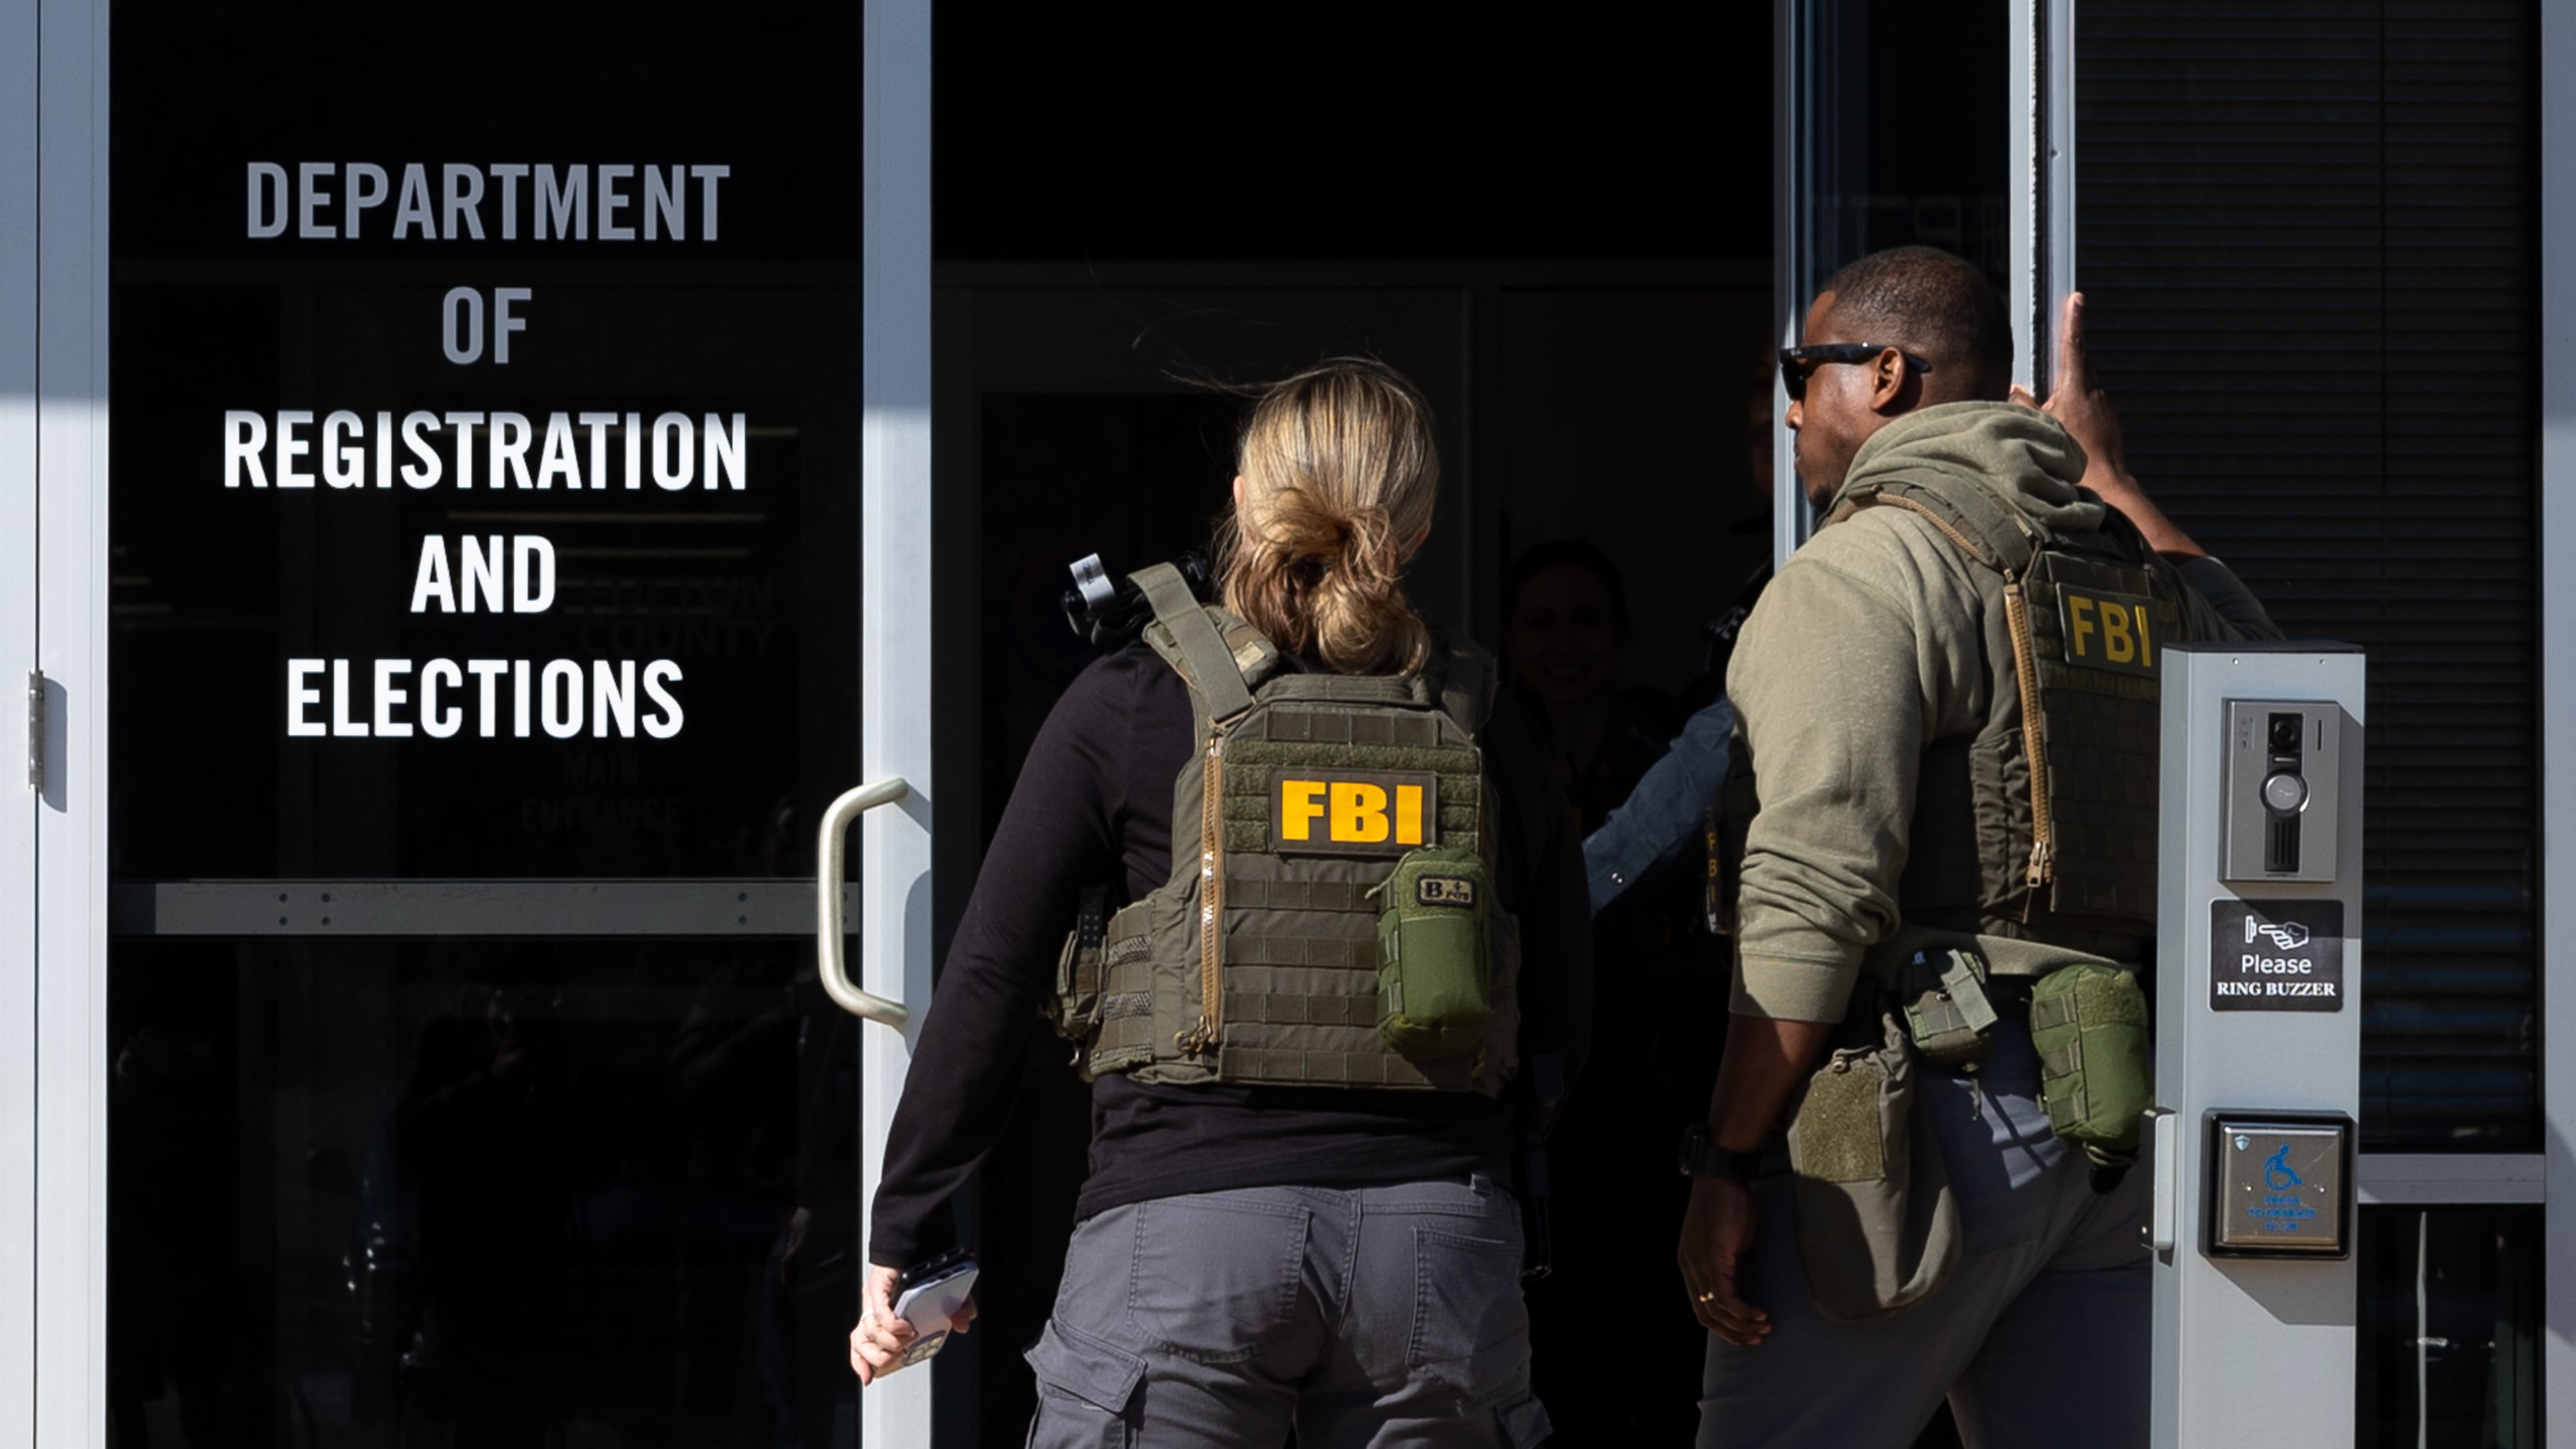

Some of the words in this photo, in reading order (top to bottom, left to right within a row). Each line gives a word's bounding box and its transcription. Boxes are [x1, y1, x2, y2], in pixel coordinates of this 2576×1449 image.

[248, 162, 731, 241] DEPARTMENT
[443, 286, 532, 365] OF
[225, 411, 746, 490] REGISTRATION
[411, 535, 555, 613] AND
[578, 619, 776, 658] COUNTY
[2069, 596, 2151, 667] FBI
[288, 658, 684, 739] ELECTIONS
[562, 752, 640, 785] MAIN
[520, 797, 681, 832] ENTRANCE
[1282, 780, 1423, 845] FBI
[1426, 881, 1442, 898] B
[1707, 831, 1719, 903] FBI
[2216, 982, 2262, 996] RING
[2265, 982, 2336, 997] BUZZER
[2242, 954, 2312, 974] Please
